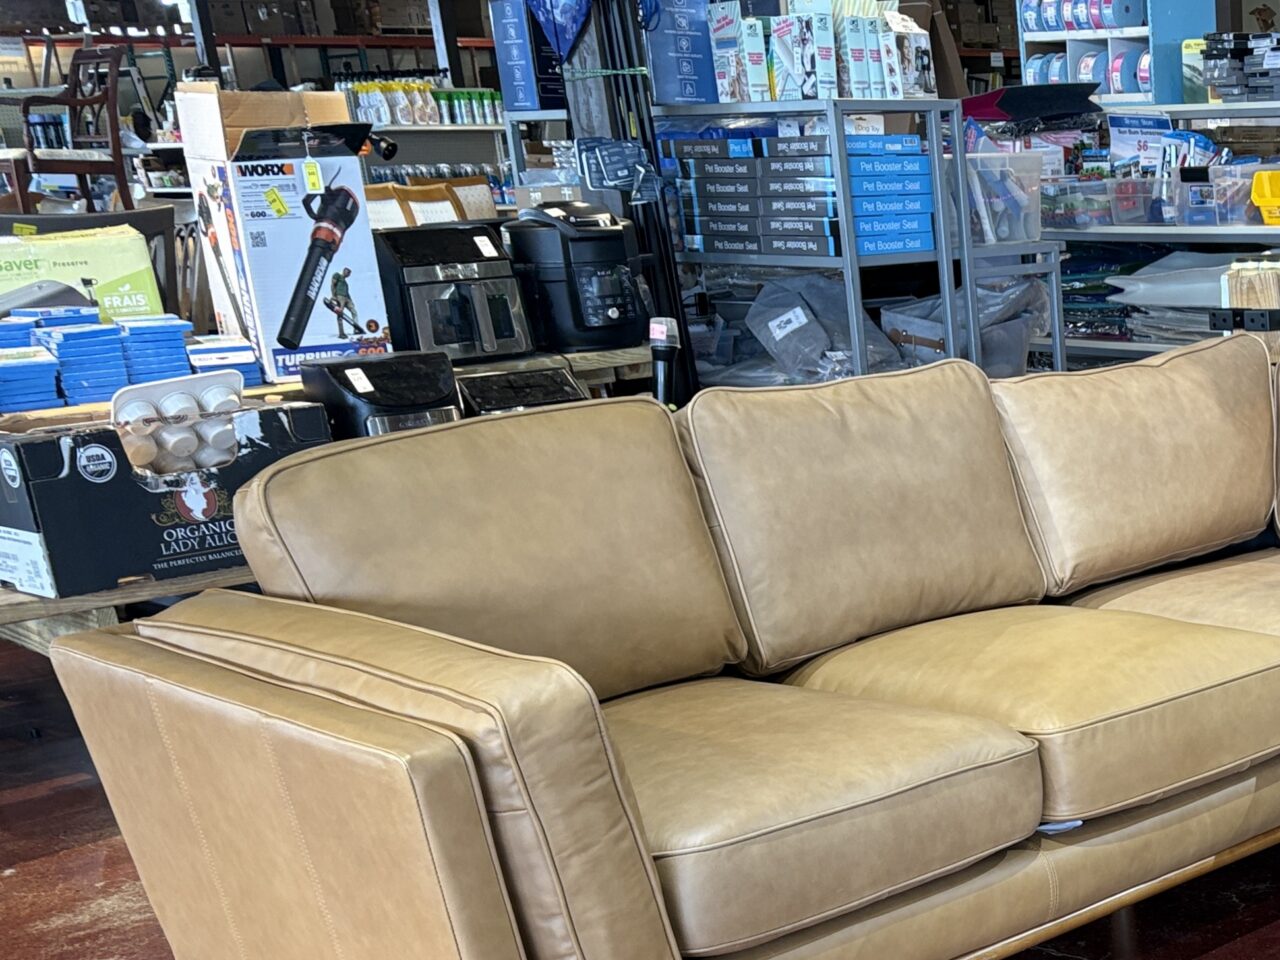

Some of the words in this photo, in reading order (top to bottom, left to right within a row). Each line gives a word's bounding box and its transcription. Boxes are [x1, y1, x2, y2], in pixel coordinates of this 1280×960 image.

[846, 141, 868, 149] ooster
[1137, 140, 1149, 152] $6
[239, 163, 286, 177] WORX
[705, 163, 713, 173] Pet
[714, 164, 734, 174] Booster
[735, 164, 748, 173] Seat
[860, 161, 873, 172] Pet
[874, 161, 902, 171] Booster
[903, 161, 919, 171] Seat
[706, 183, 715, 192] Pet
[716, 184, 735, 193] Booster
[736, 183, 749, 193] Seat
[863, 181, 873, 191] Pet
[874, 181, 903, 191] Booster
[904, 180, 920, 190] Seat
[708, 202, 717, 211] Pet
[718, 203, 737, 212] Booster
[738, 202, 750, 212] Seat
[863, 201, 873, 211] Pet
[876, 201, 903, 211] Booster
[904, 200, 920, 210] Seat
[709, 222, 717, 231] Pet
[718, 222, 736, 231] Booster
[737, 222, 748, 231] Seat
[860, 222, 872, 231] Pet
[873, 221, 901, 231] Booster
[902, 220, 918, 229] Seat
[714, 240, 723, 250] Pet
[724, 241, 744, 250] Booster
[744, 241, 758, 250] Seat
[864, 241, 876, 251] Pet
[878, 240, 904, 250] Booster
[905, 238, 920, 249] Seat
[103, 294, 146, 308] FRAIS
[86, 453, 106, 463] USDA
[163, 519, 236, 541] ORGANIC
[160, 538, 199, 555] LADY
[205, 531, 240, 548] ALIC
[152, 562, 169, 570] THE
[169, 555, 207, 568] PERFECTLY
[208, 549, 243, 561] BALANCE
